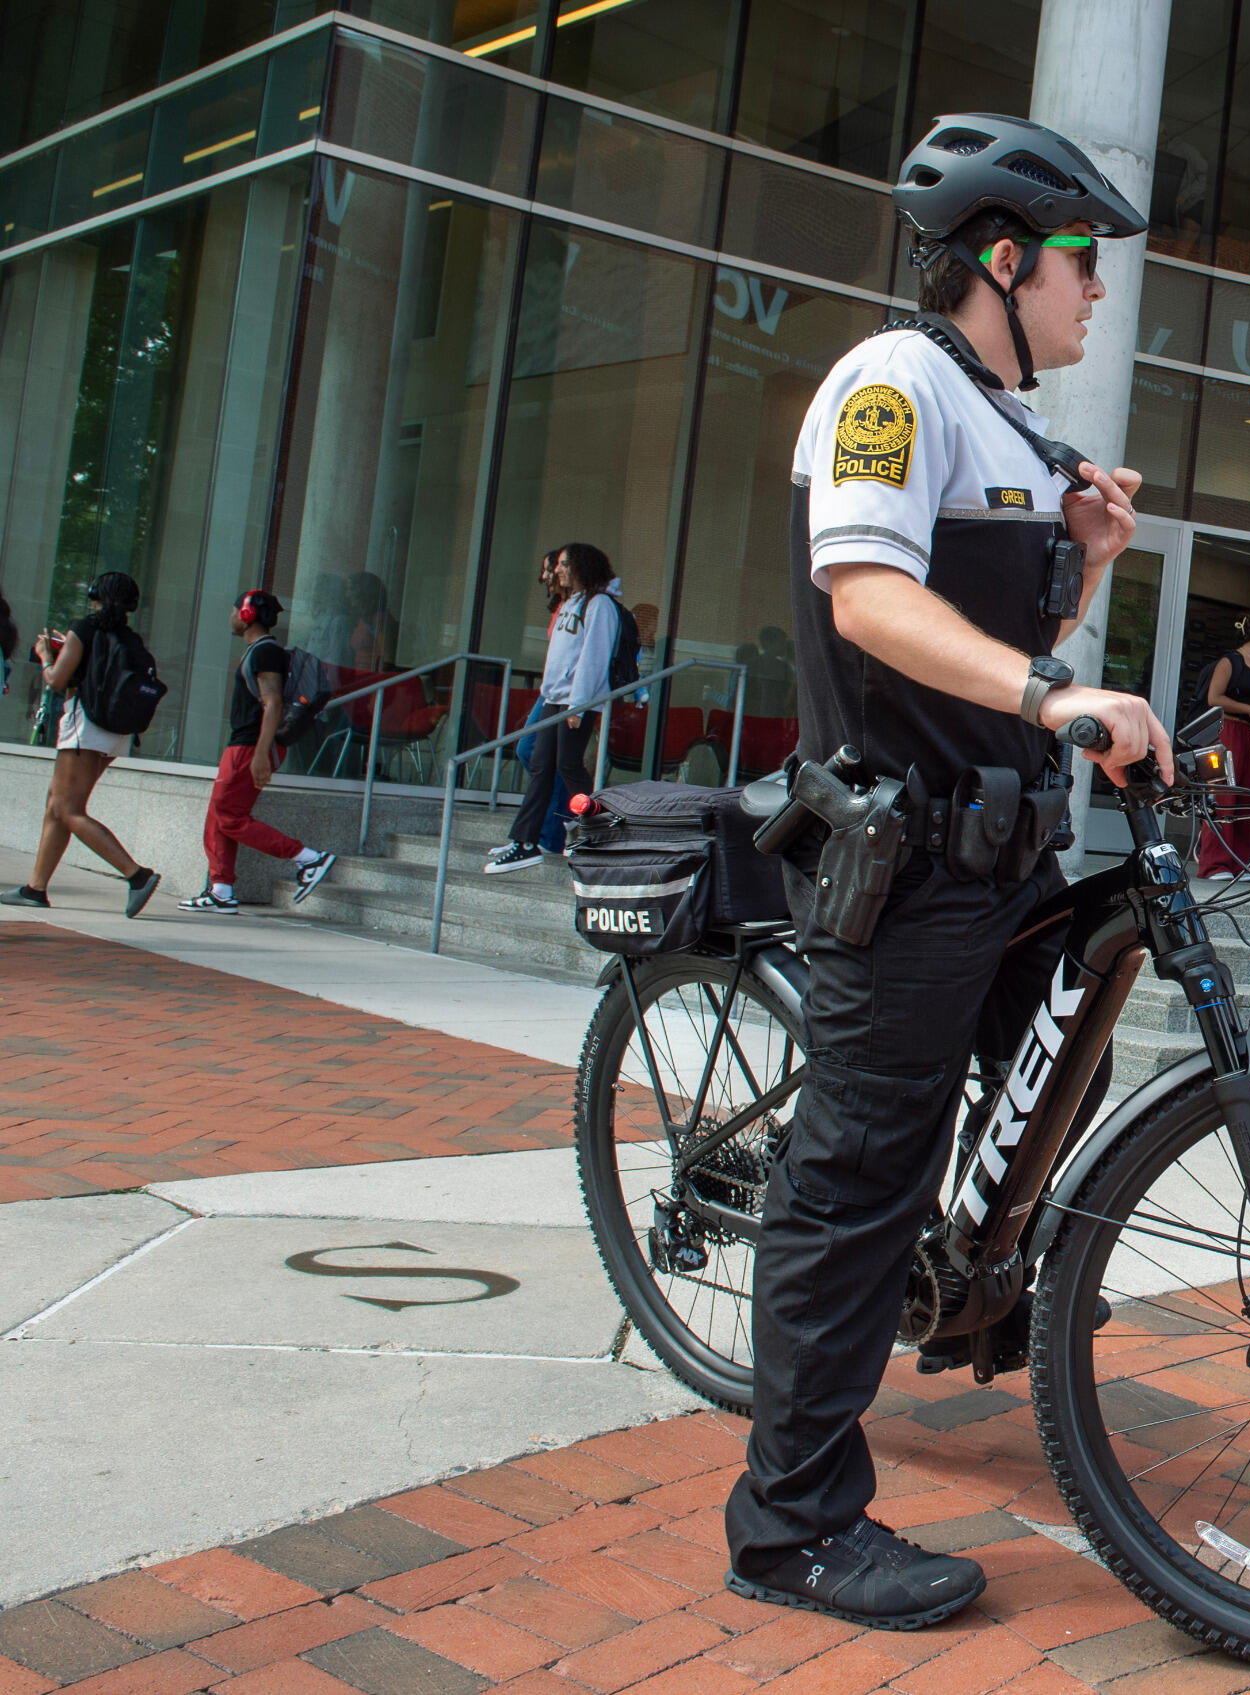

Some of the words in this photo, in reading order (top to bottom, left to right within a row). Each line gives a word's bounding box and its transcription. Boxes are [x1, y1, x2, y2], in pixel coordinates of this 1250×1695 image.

[844, 386, 912, 414] COMMONWEALTH
[839, 420, 857, 450] VIRGINIA
[867, 422, 913, 452] UNIVERSITY
[836, 459, 903, 480] POLICE
[1001, 490, 1026, 505] GREEN
[586, 908, 652, 933] POLICE
[951, 954, 1086, 1226] TREK
[676, 1247, 704, 1265] NX
[285, 1240, 521, 1312] S
